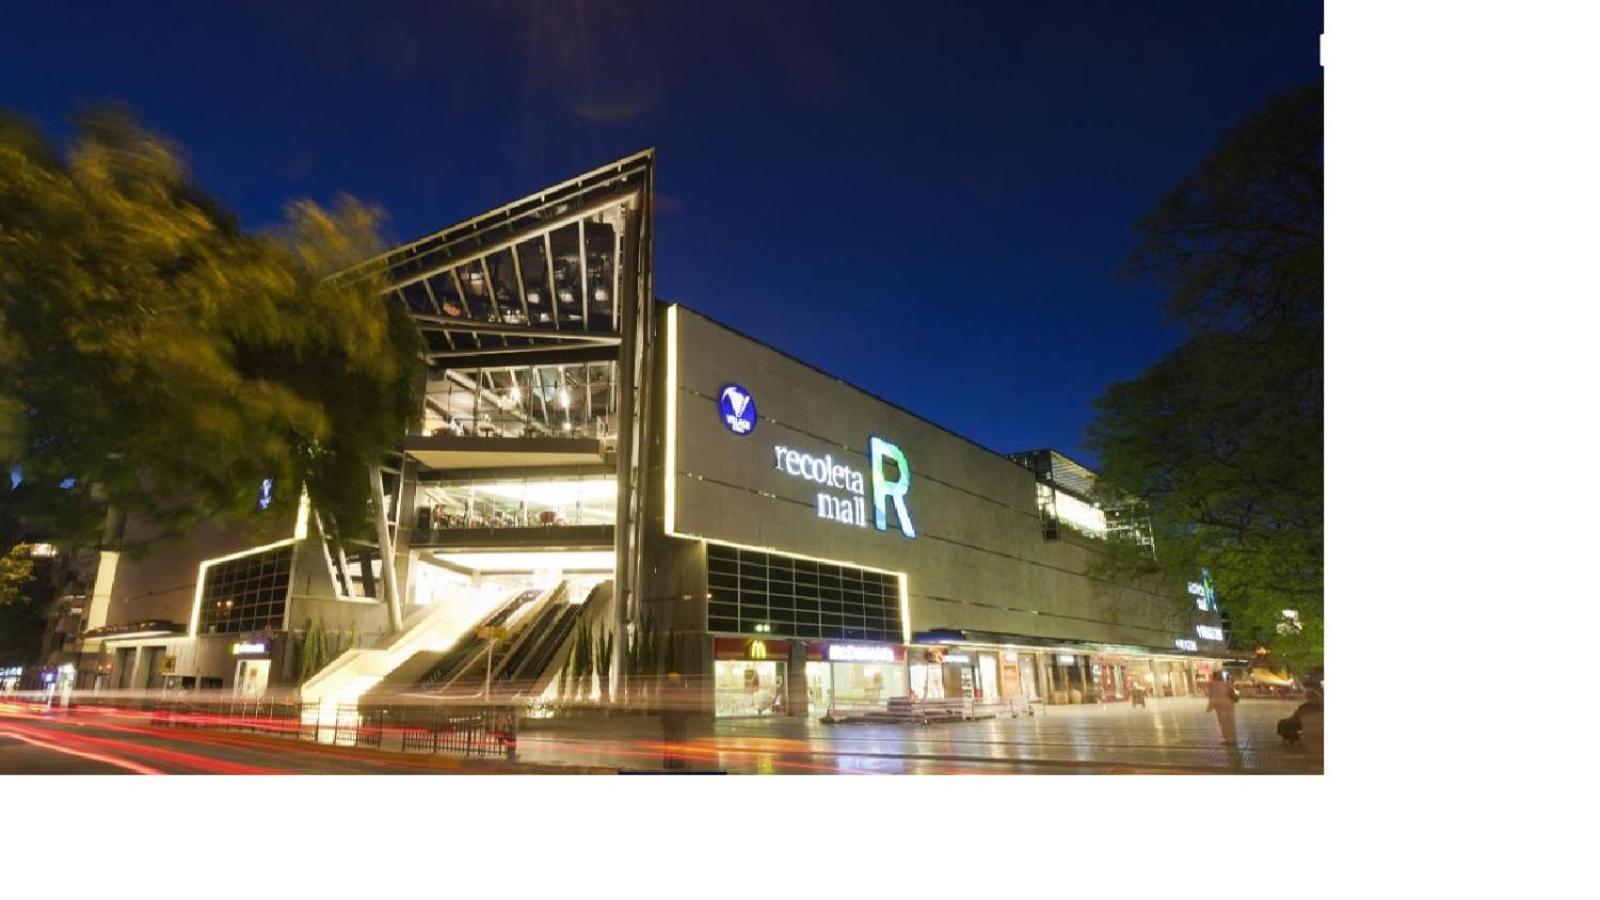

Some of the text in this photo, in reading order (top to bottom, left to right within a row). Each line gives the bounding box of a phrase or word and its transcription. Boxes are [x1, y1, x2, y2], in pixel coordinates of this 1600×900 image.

[774, 445, 865, 495] recoleta
[870, 436, 915, 538] R
[817, 493, 866, 528] mall
